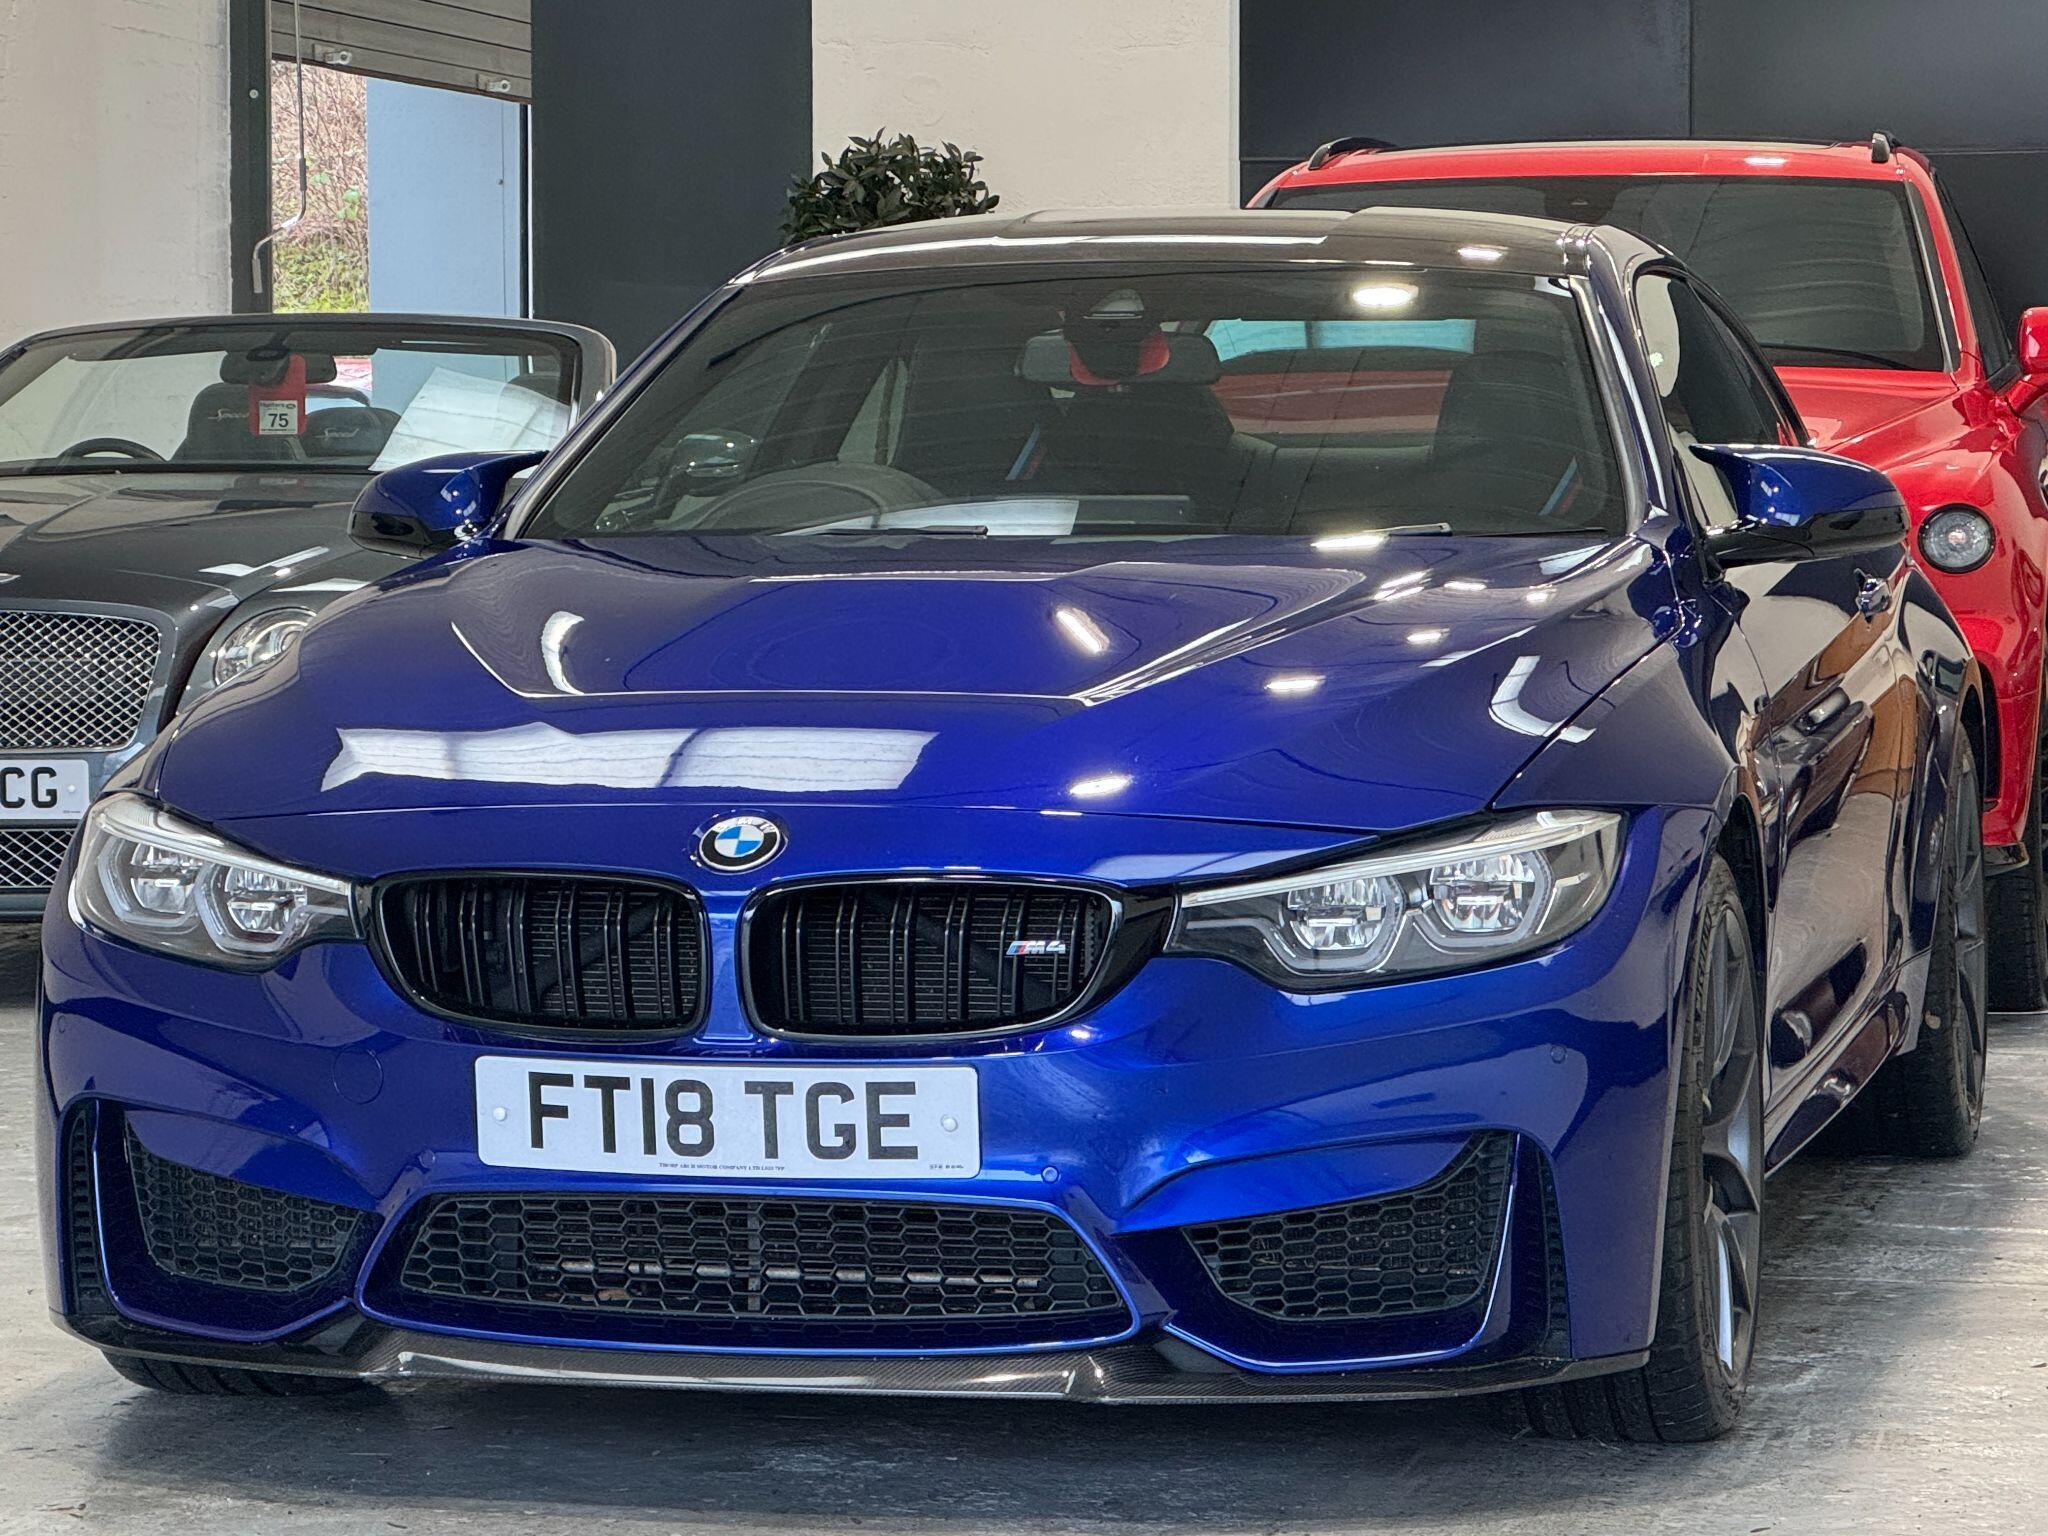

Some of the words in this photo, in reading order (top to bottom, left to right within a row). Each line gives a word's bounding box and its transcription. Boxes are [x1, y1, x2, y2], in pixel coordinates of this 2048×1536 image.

[268, 413, 289, 428] 75
[0, 766, 57, 809] CG
[712, 818, 776, 833] MW
[1025, 940, 1066, 955] M4
[528, 1071, 715, 1157] FT18
[744, 1080, 919, 1160] TGE
